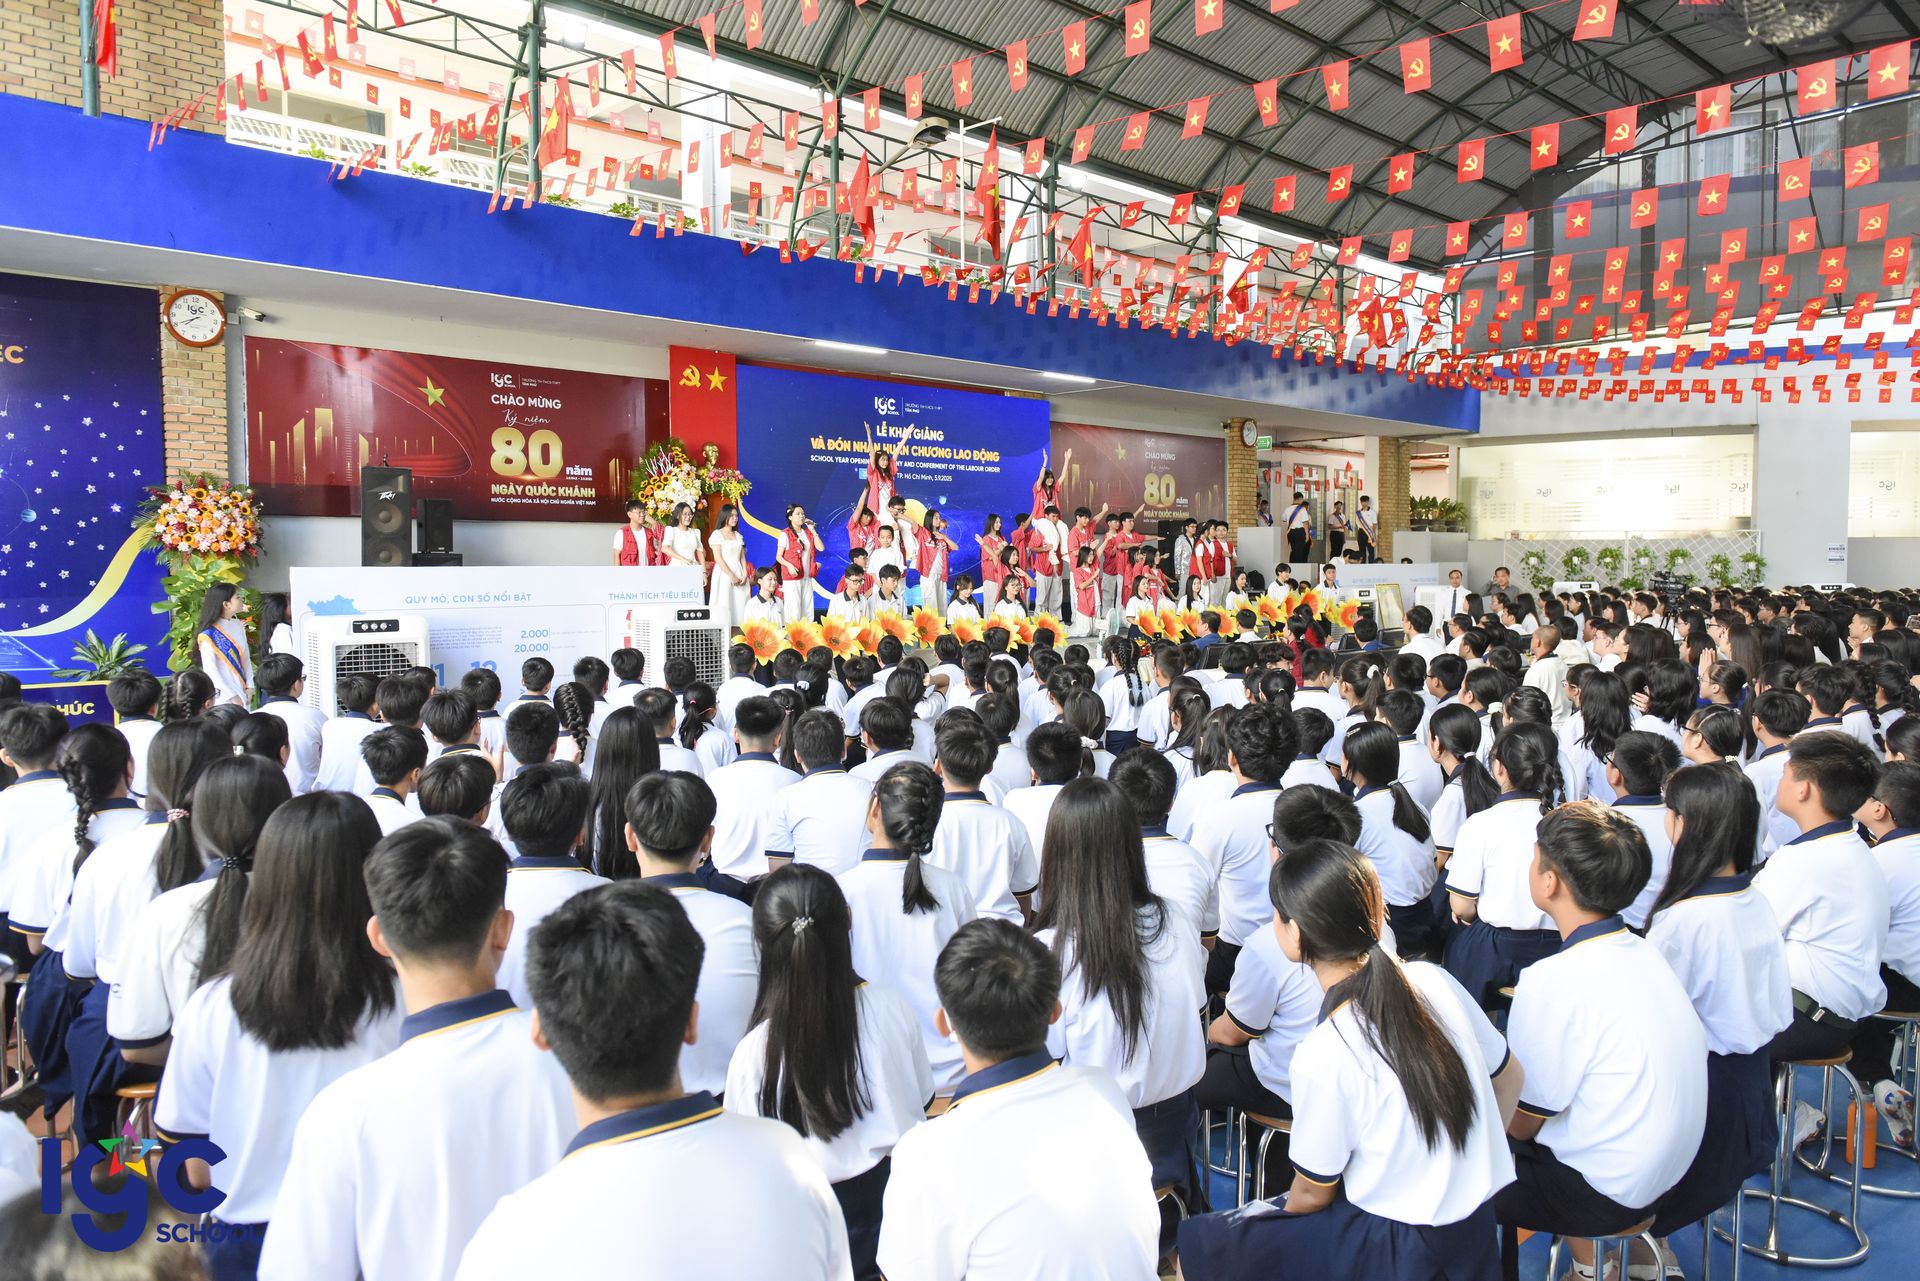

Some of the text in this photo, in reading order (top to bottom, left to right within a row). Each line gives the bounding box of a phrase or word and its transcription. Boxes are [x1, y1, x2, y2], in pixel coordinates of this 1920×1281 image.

[192, 296, 200, 304] 12
[0, 344, 25, 364] C
[491, 393, 561, 409] CHÀO MỪNG
[876, 421, 944, 441] LỄ KHA GIẢNG
[490, 426, 564, 478] 80
[811, 435, 826, 450] VÀ
[827, 437, 851, 451] ĐÓN
[911, 445, 952, 459] CHƯƠNG
[953, 449, 972, 460] LAO
[973, 448, 1000, 463] ĐỘNG
[566, 465, 592, 476] năm
[491, 482, 596, 498] NGÀY QUỐC KHÁNH
[1144, 472, 1176, 507] 80
[405, 595, 427, 604] QUY
[431, 594, 449, 604] MÔ,
[452, 594, 474, 603] CON
[478, 592, 491, 602] SỐ
[493, 590, 511, 602] NỔI
[608, 588, 699, 600] THÀNH TÍCH TIÊU BIỂU
[520, 629, 548, 639] 2.000
[514, 643, 548, 653] 20.000
[50, 700, 95, 716] HÚC
